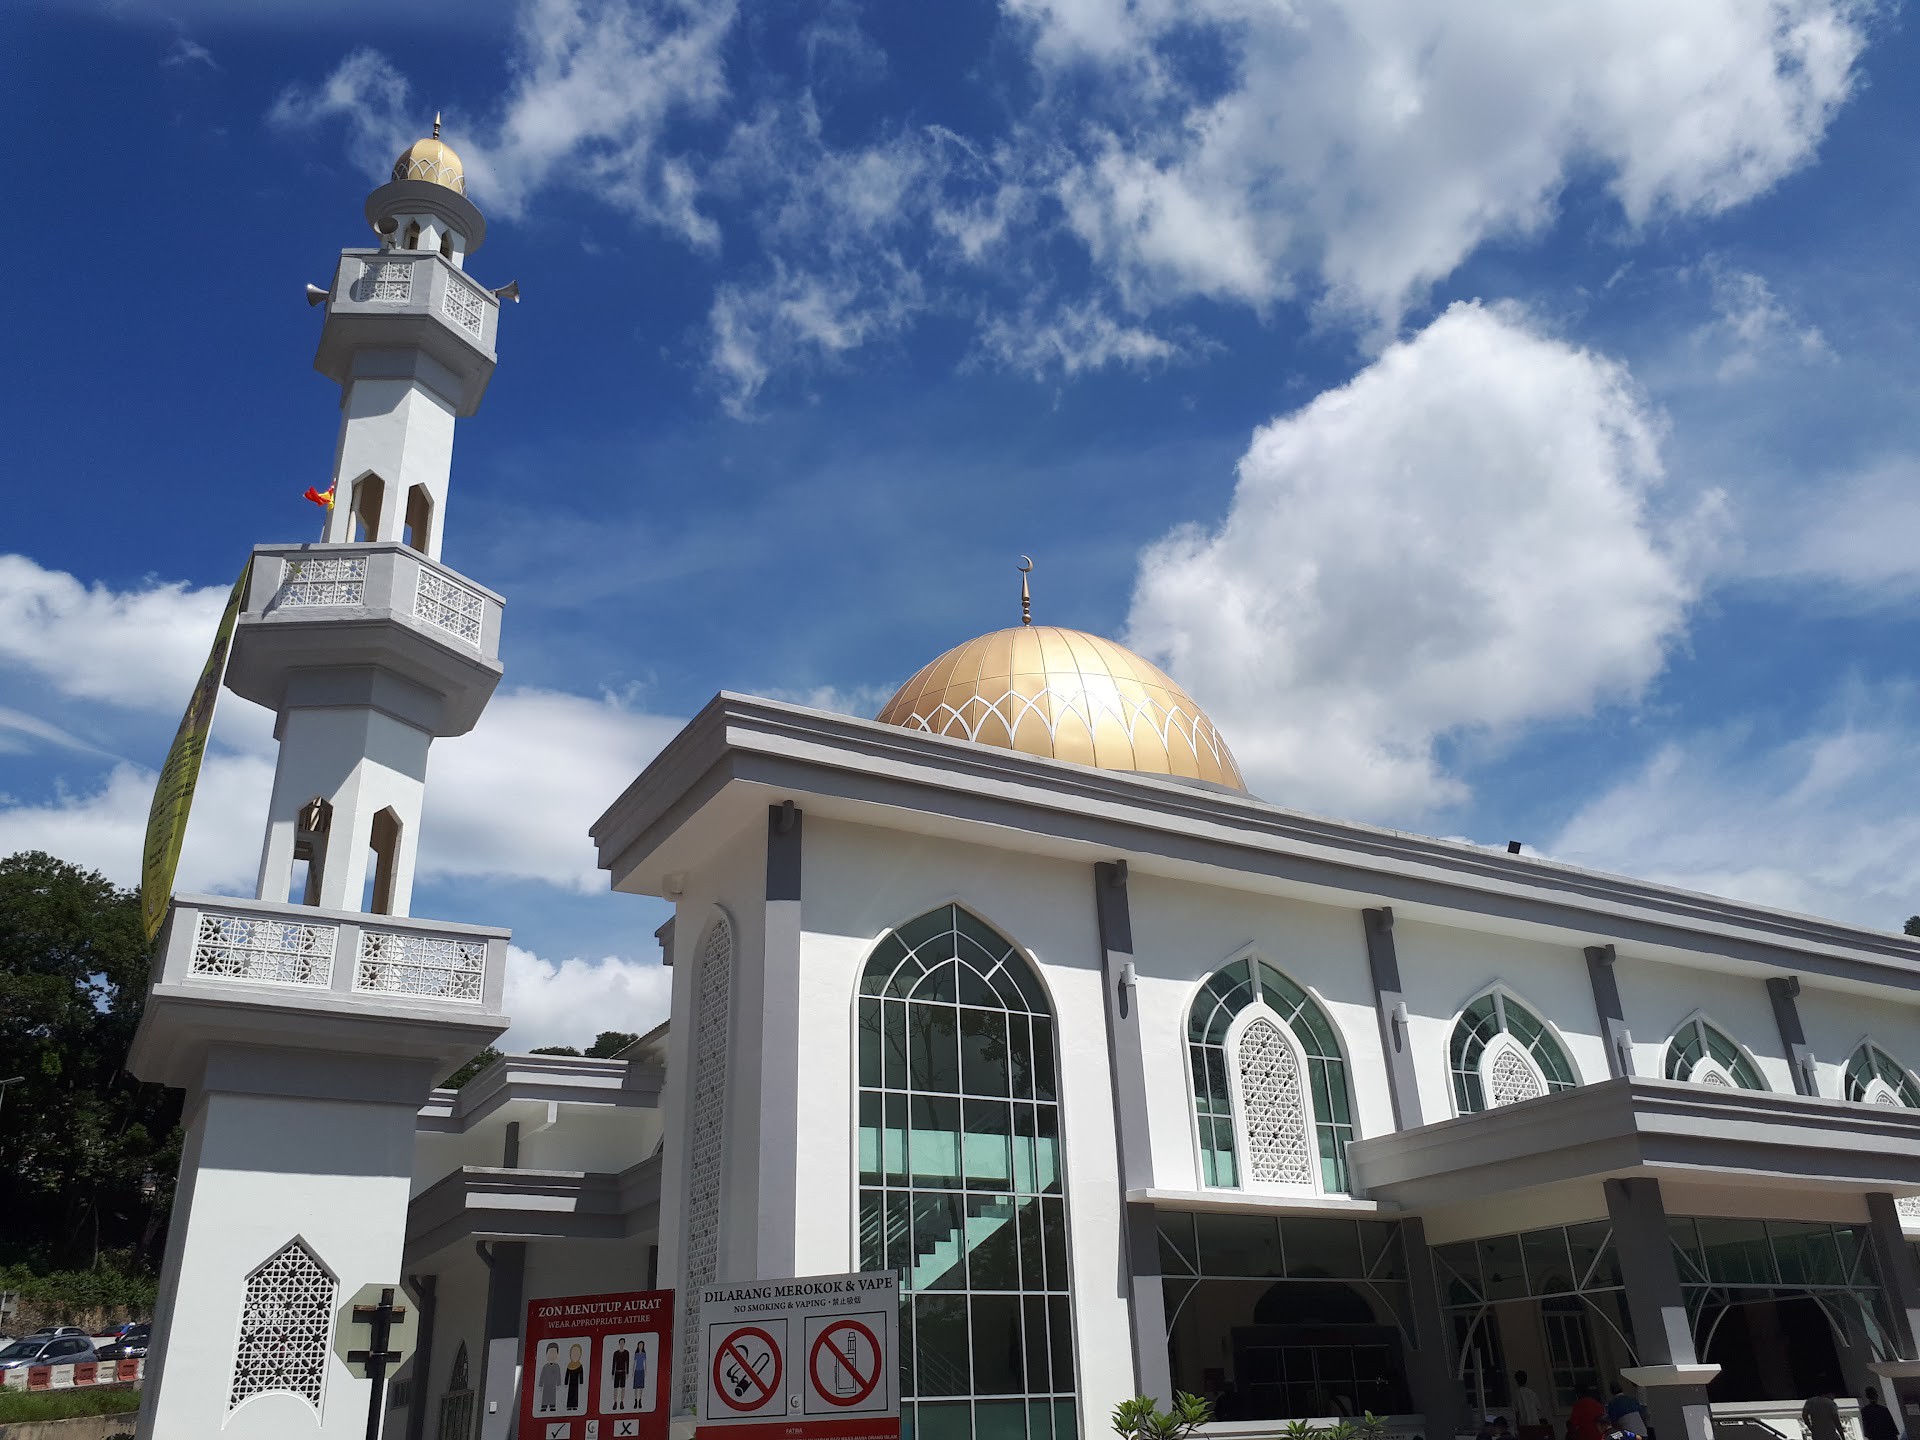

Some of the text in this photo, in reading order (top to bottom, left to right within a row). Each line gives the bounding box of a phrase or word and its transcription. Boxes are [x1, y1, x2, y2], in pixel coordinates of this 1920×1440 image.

[705, 1277, 893, 1303] DILARANG MEROKOK & VAPE
[538, 1298, 662, 1317] ZON MENUTUP AURAT
[734, 1299, 826, 1314] NO SMOKING & VAPING
[548, 1314, 651, 1329] WEAR APPROPRIATE ATTIRE
